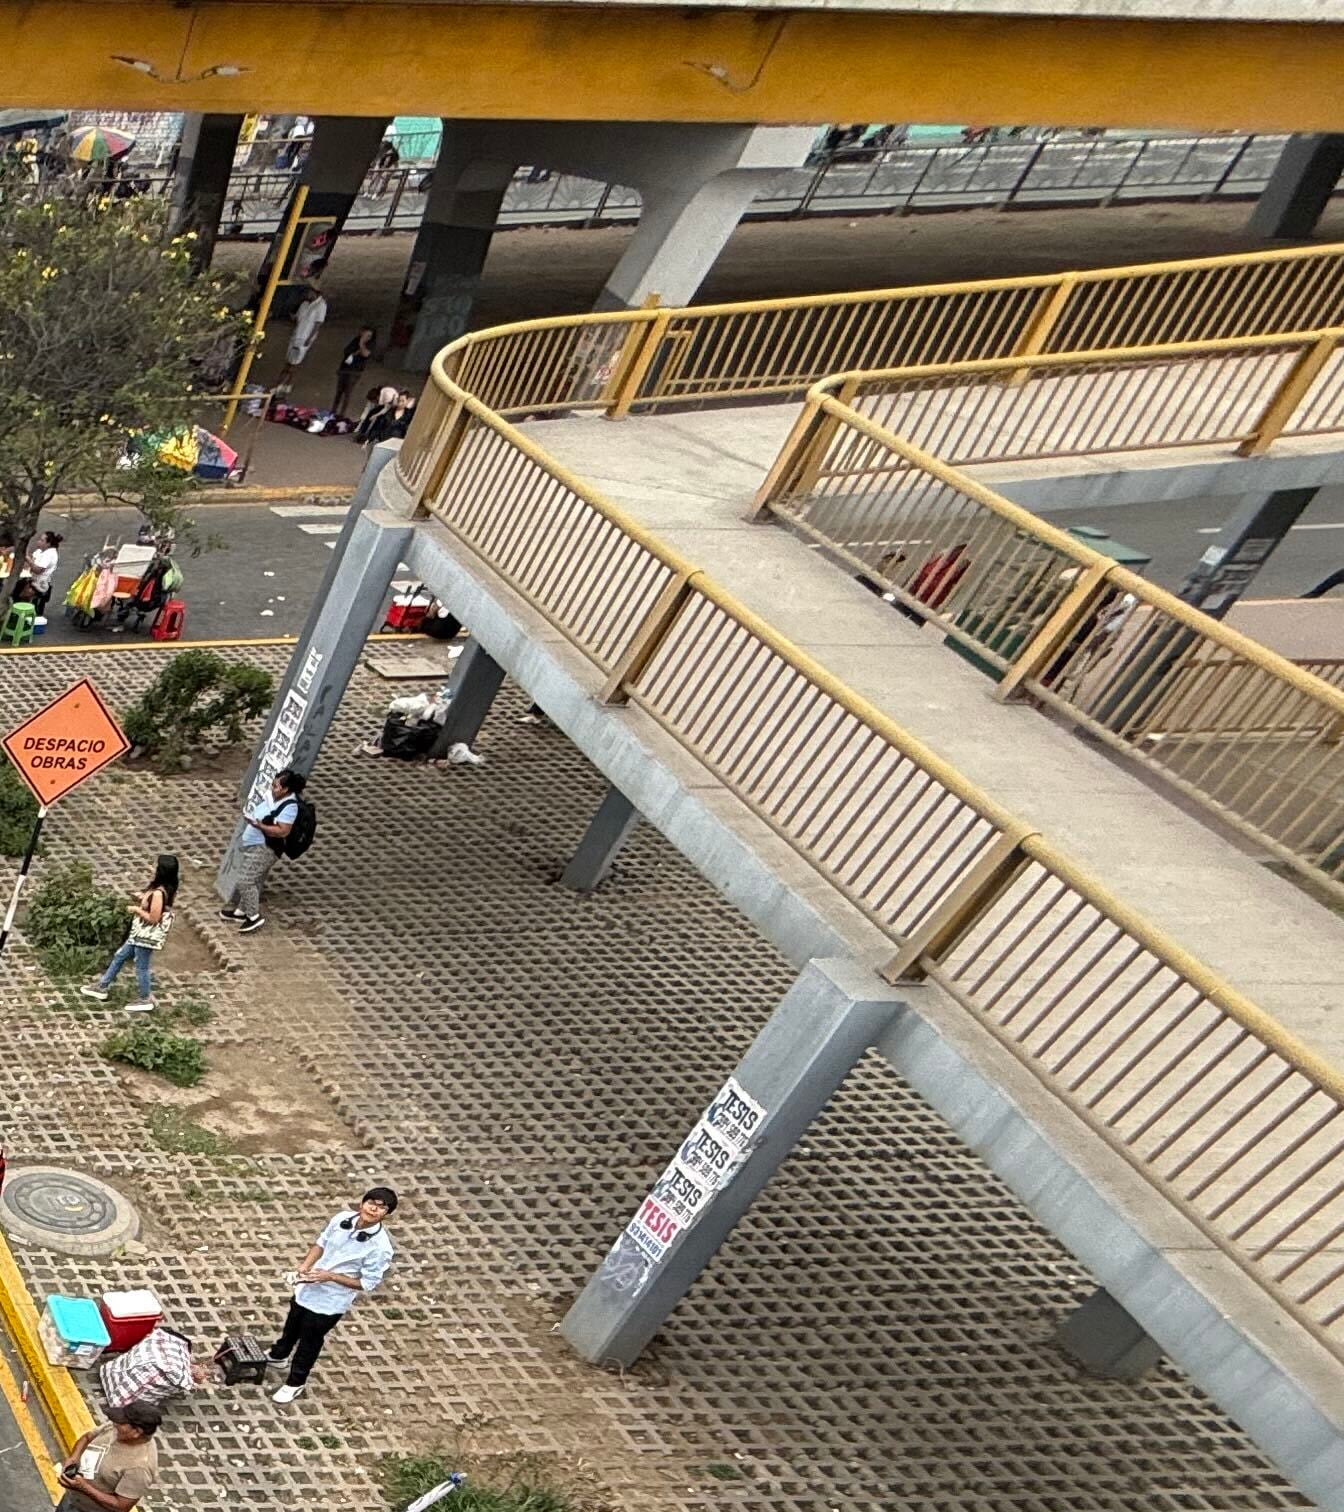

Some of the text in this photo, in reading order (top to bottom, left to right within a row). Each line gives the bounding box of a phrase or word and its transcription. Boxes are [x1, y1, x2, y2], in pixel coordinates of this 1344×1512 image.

[23, 737, 106, 753] DESPACIO
[30, 756, 88, 770] OBRAS
[722, 1089, 759, 1131] TESIS
[696, 1128, 730, 1170] TESIS
[669, 1167, 703, 1207] TESIS
[639, 1199, 678, 1244] TESIS
